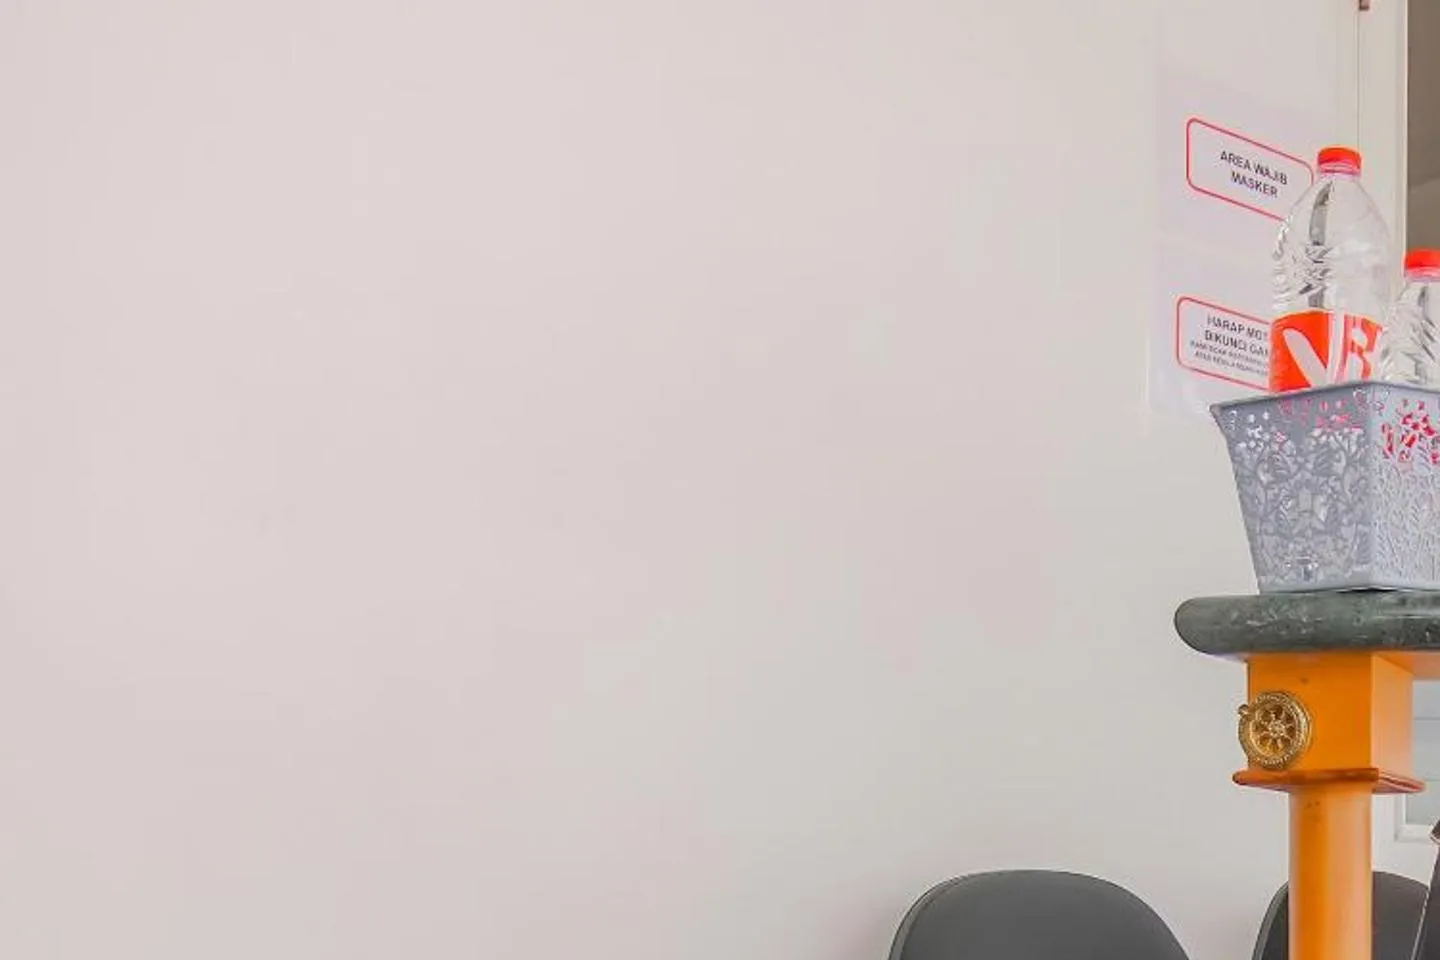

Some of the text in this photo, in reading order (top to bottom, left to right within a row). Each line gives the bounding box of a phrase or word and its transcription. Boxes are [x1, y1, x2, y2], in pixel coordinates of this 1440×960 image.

[1220, 150, 1288, 185] AREA WAJIB
[1231, 170, 1278, 198] MASKER
